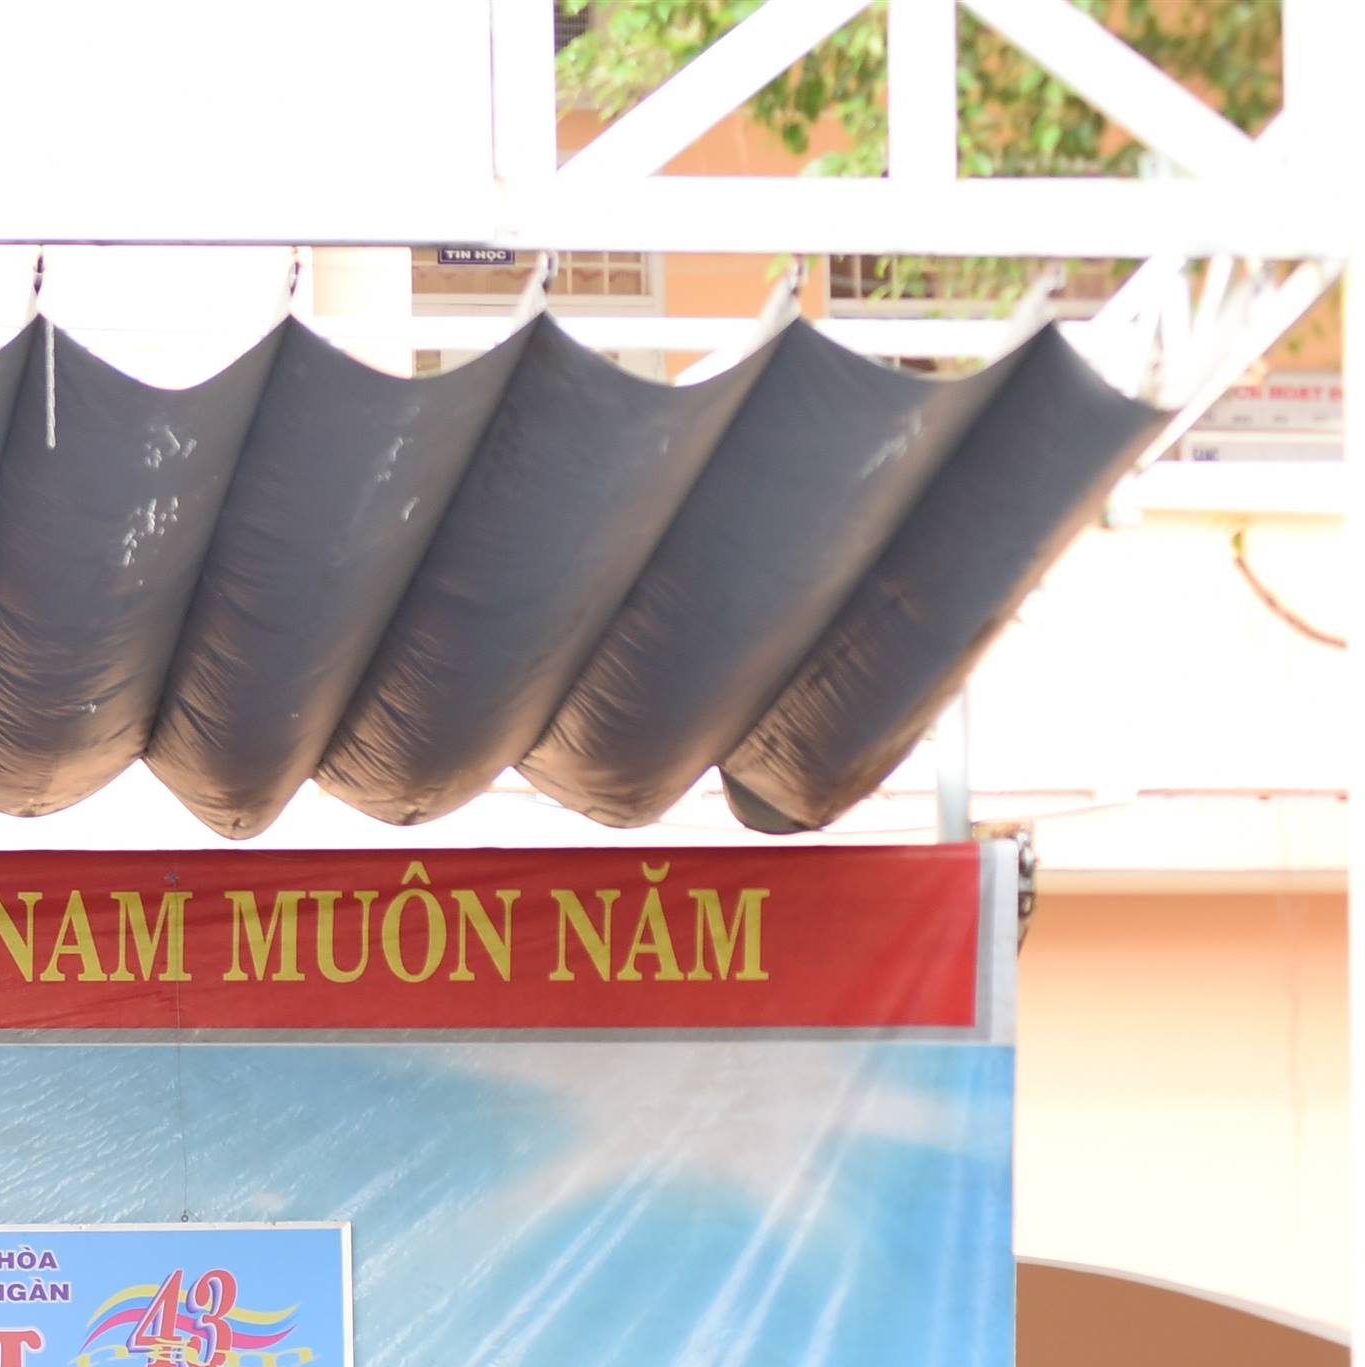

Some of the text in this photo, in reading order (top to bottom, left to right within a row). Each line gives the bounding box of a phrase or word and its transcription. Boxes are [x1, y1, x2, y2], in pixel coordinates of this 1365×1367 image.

[446, 249, 507, 262] TIN HỌC
[224, 861, 522, 984] MUÔN
[549, 863, 771, 982] NĂM
